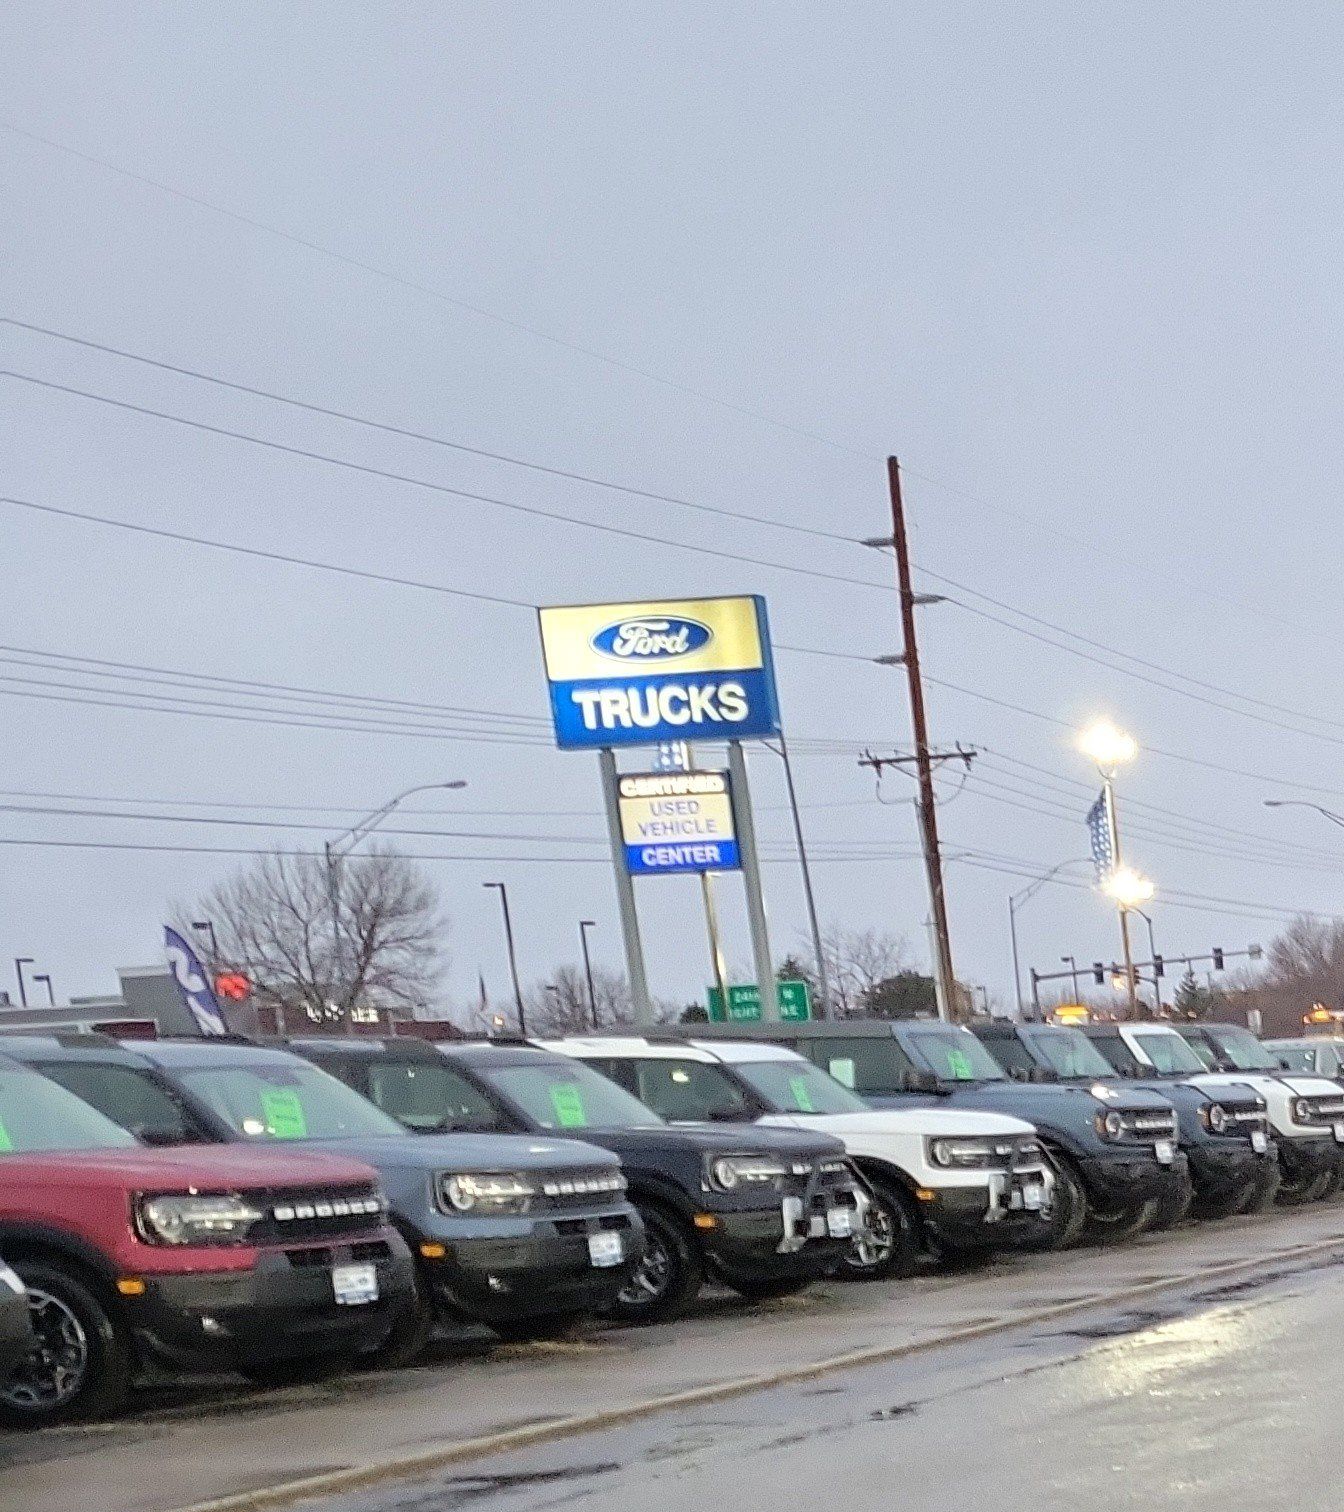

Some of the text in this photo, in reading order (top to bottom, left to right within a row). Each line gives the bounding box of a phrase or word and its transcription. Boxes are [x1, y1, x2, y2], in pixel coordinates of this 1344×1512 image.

[613, 621, 690, 656] Ford
[571, 683, 750, 730] TRUCKS
[649, 800, 700, 817] USED
[637, 819, 719, 838] VEHICLE
[641, 845, 721, 866] CENTER
